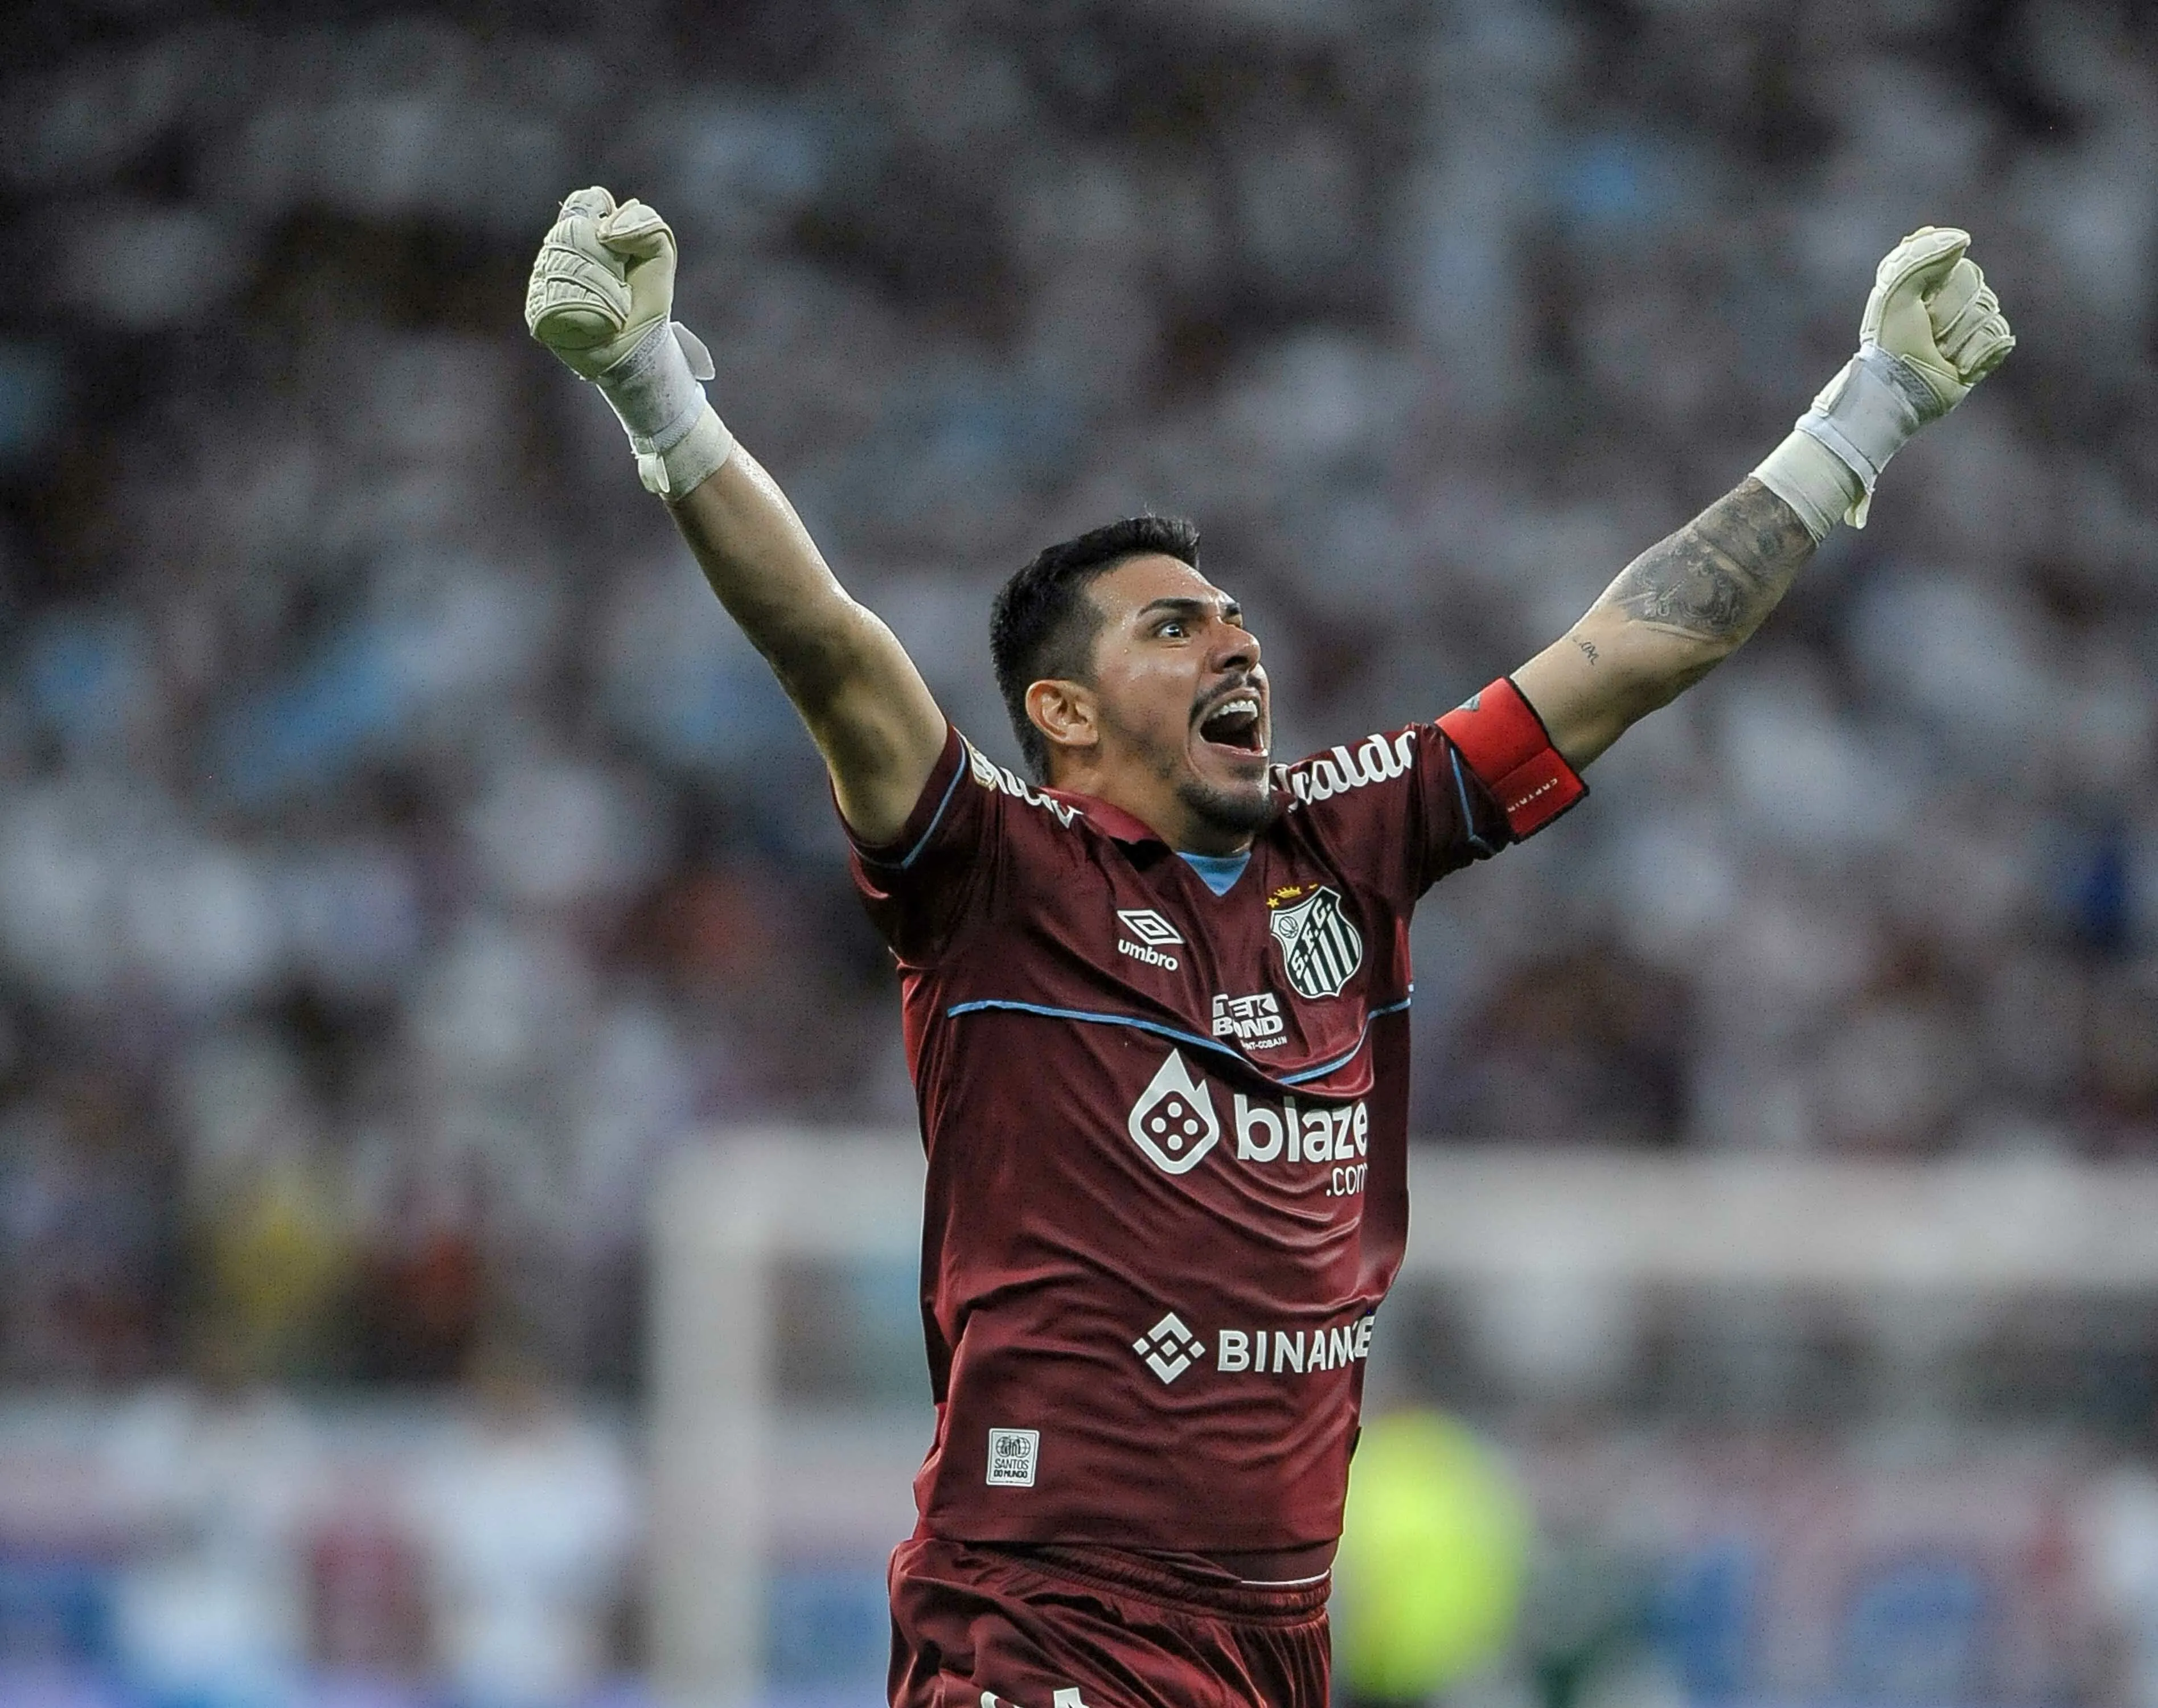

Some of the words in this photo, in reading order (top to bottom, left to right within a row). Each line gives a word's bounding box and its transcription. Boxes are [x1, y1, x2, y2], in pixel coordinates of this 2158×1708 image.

[1507, 778, 1558, 812] CAPTAIN
[1118, 939, 1178, 971] umbro
[1233, 1094, 1368, 1162] blaze
[1217, 1315, 1375, 1373] BINANE
[994, 1458, 1029, 1469] SANTOS
